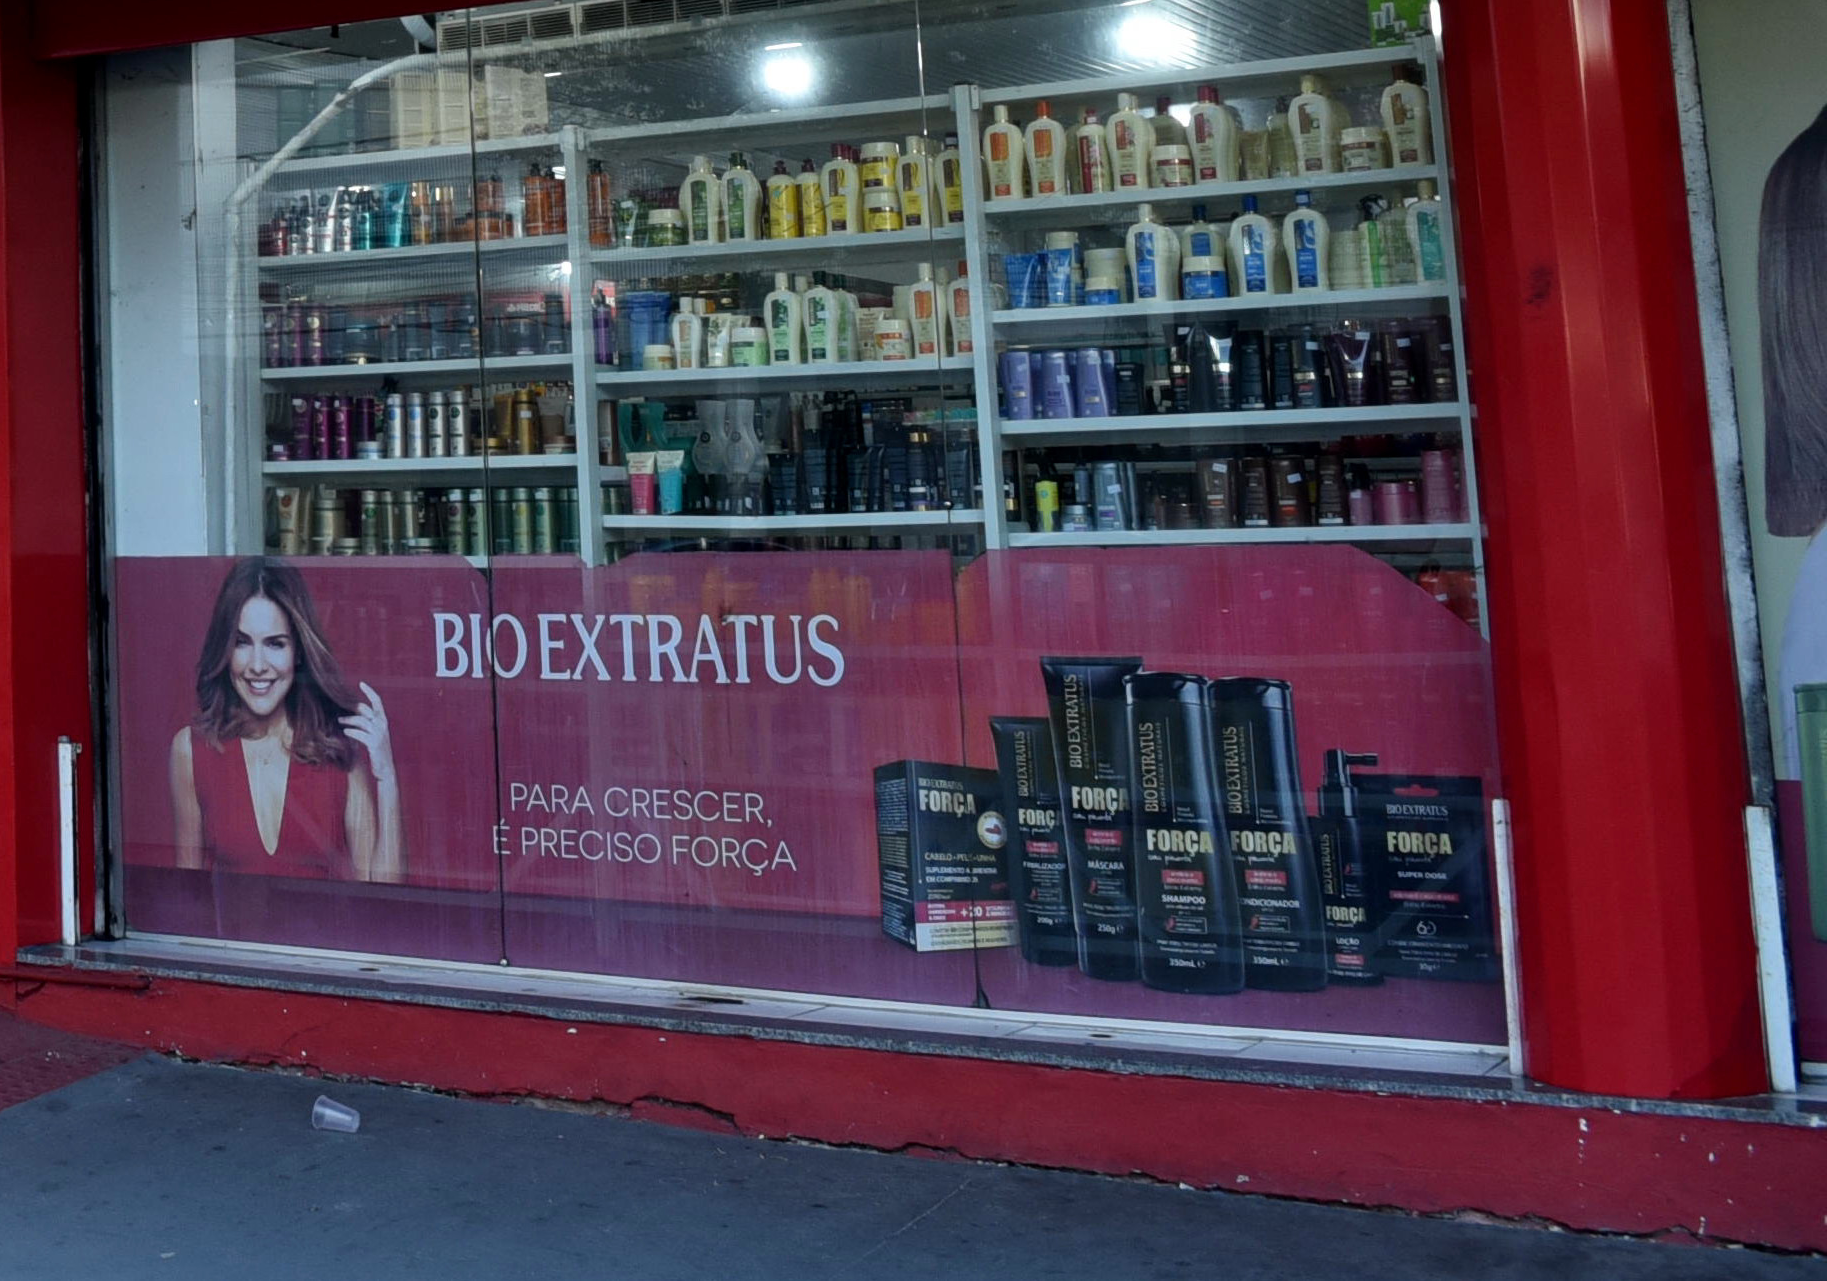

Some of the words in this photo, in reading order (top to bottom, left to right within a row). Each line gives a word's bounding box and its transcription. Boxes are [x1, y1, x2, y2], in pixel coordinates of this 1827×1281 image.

[510, 782, 595, 816] PARA
[603, 786, 773, 829] CRESCER,
[1071, 785, 1131, 816] FORÇA
[492, 818, 511, 855] É
[522, 826, 662, 864] PRECISO
[672, 835, 798, 877] FORÇA
[1146, 828, 1214, 857] FORÇA
[1229, 830, 1297, 858] FORÇA
[1386, 830, 1453, 858] FORÇA
[1161, 894, 1207, 905] SHAMPOO
[1239, 897, 1300, 909] ONDICIONADOR
